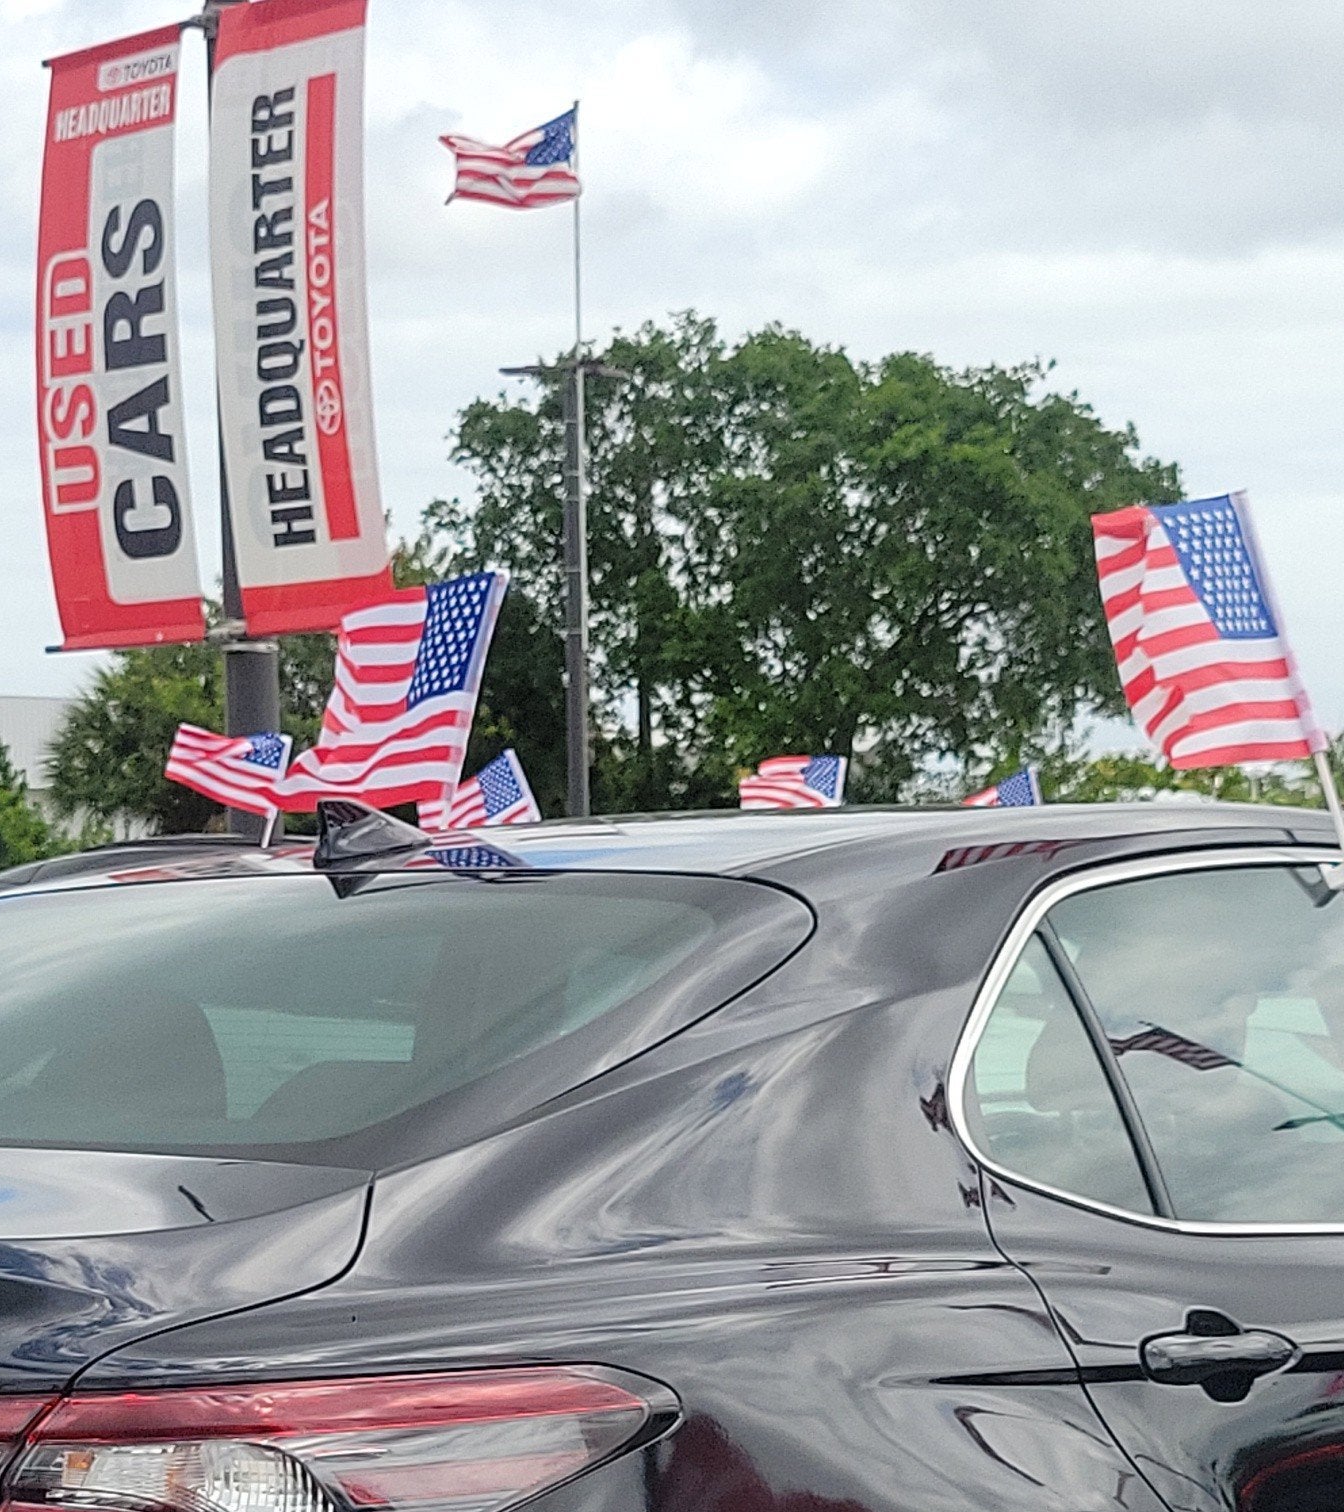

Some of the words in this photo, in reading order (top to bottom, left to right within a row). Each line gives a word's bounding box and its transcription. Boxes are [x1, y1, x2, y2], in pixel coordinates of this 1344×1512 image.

[54, 83, 171, 143] HEADQUARTER
[123, 54, 173, 82] TOYOTA
[47, 252, 101, 509] USED
[102, 198, 183, 561] CARS
[251, 86, 316, 547] HEADQUARTER
[307, 197, 336, 378] TOYOTA
